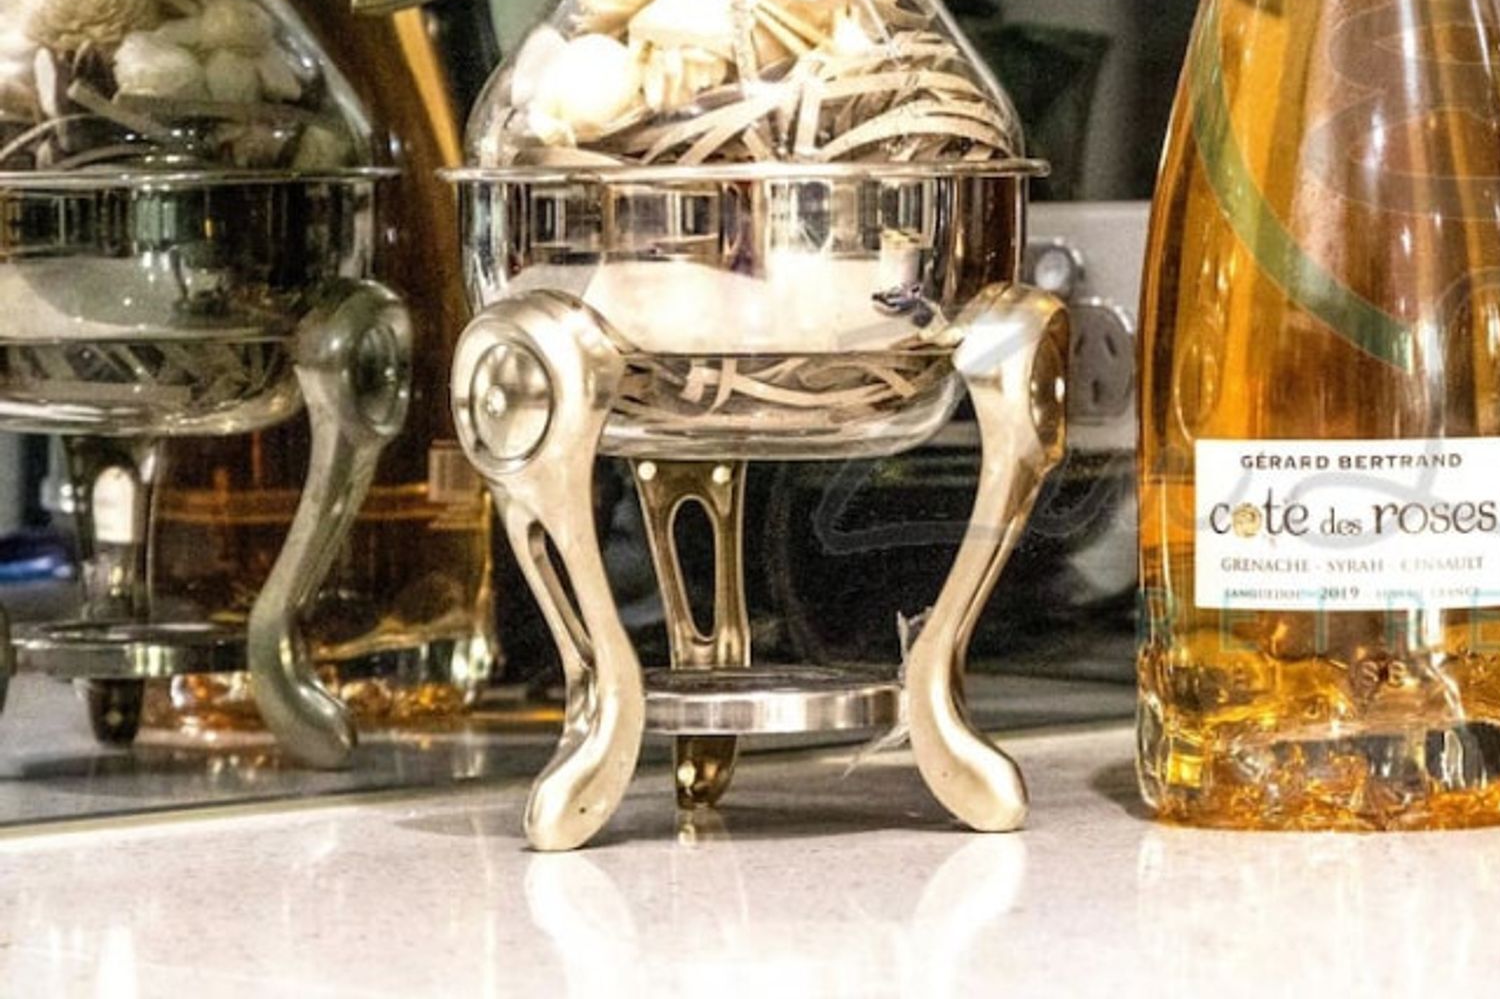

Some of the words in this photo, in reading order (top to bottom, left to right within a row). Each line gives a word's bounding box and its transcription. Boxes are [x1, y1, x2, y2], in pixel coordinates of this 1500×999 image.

[1240, 450, 1330, 470] GÉRARD
[1338, 453, 1463, 470] BERTRAND
[1320, 506, 1363, 536] des
[1372, 500, 1499, 535] roses
[1220, 556, 1309, 573] GRENACHE
[1327, 557, 1384, 573] SYRAH
[1319, 586, 1360, 601] 2019
